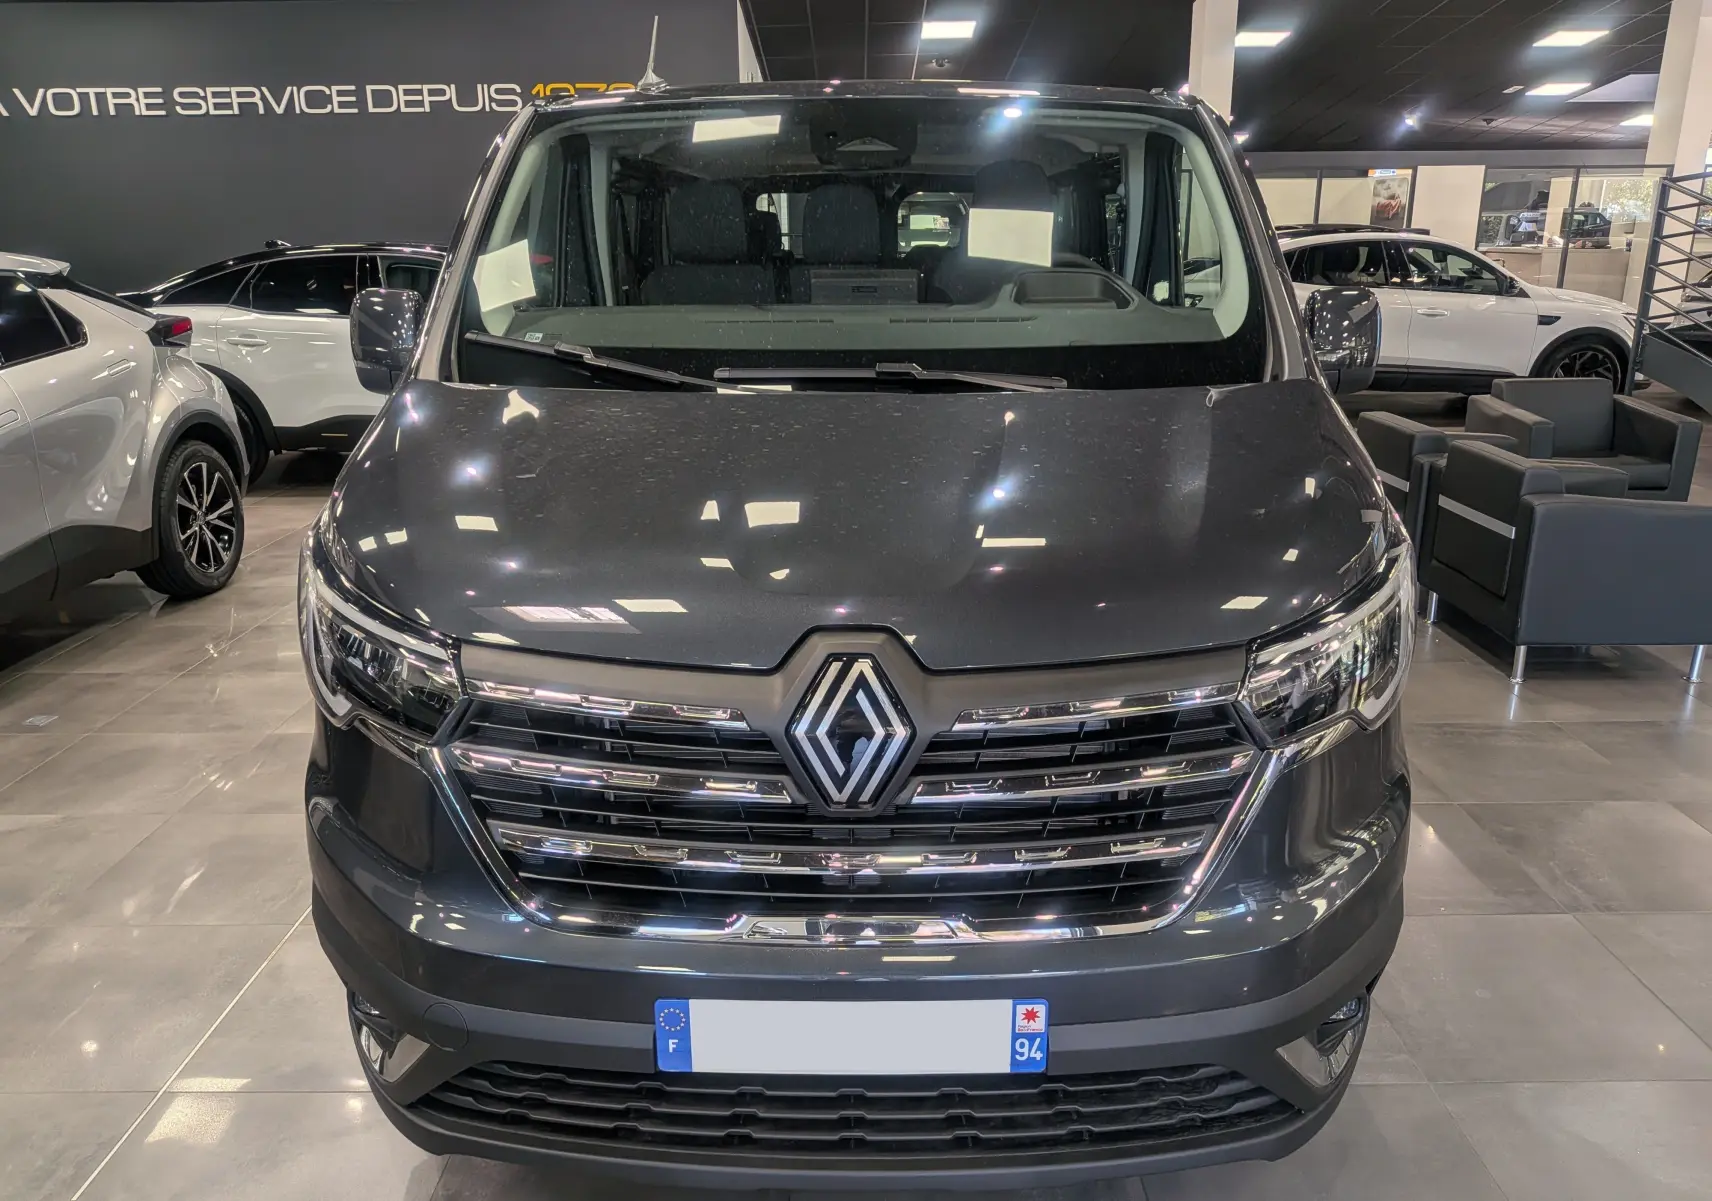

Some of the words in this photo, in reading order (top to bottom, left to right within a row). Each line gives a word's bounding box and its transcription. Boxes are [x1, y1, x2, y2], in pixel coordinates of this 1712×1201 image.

[12, 87, 167, 117] VOTRE
[173, 85, 359, 116] SERVICE
[366, 83, 523, 113] DEPUIS
[669, 1039, 679, 1053] F
[1015, 1037, 1044, 1061] 94
